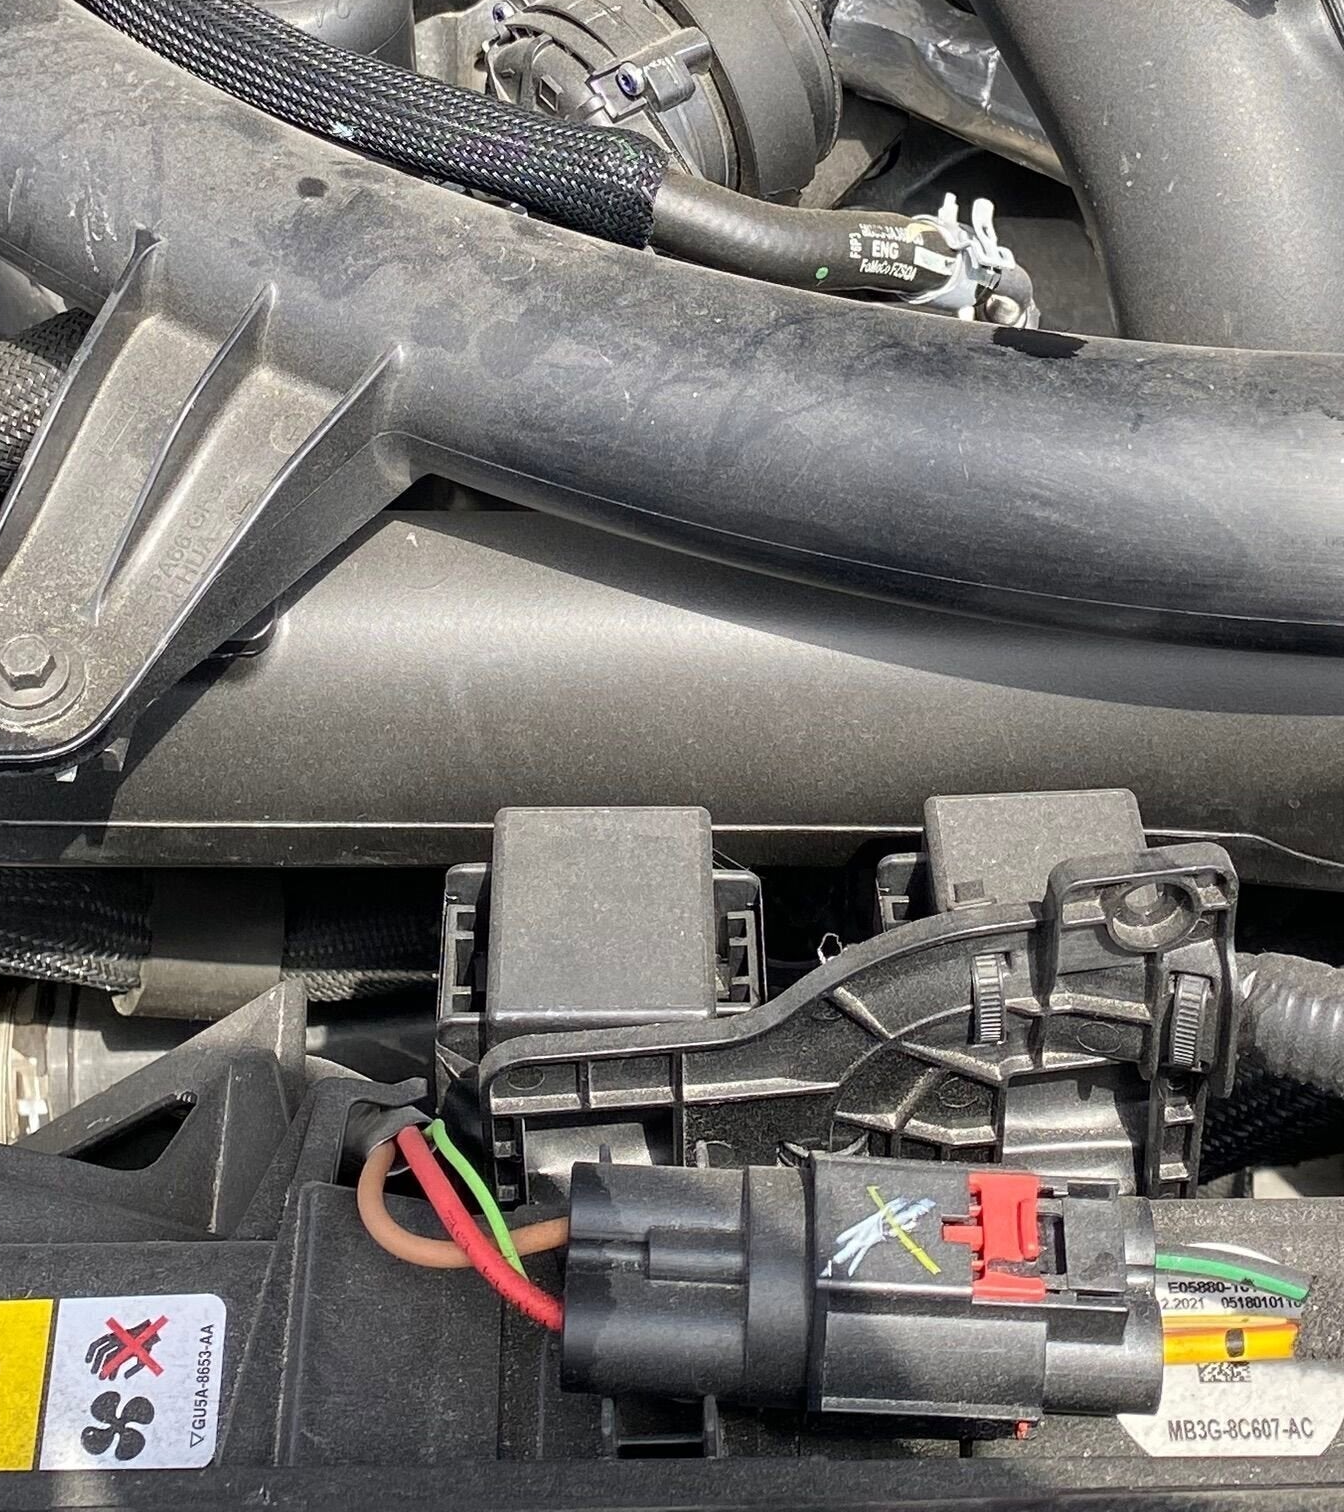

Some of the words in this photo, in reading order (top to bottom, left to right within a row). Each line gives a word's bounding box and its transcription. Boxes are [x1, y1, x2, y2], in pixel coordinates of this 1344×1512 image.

[870, 238, 900, 260] ENG
[858, 257, 892, 276] FoMoCo
[190, 1323, 215, 1430] GU5A-8653-AA
[1167, 1417, 1315, 1442] MB3G-8C607-AC
